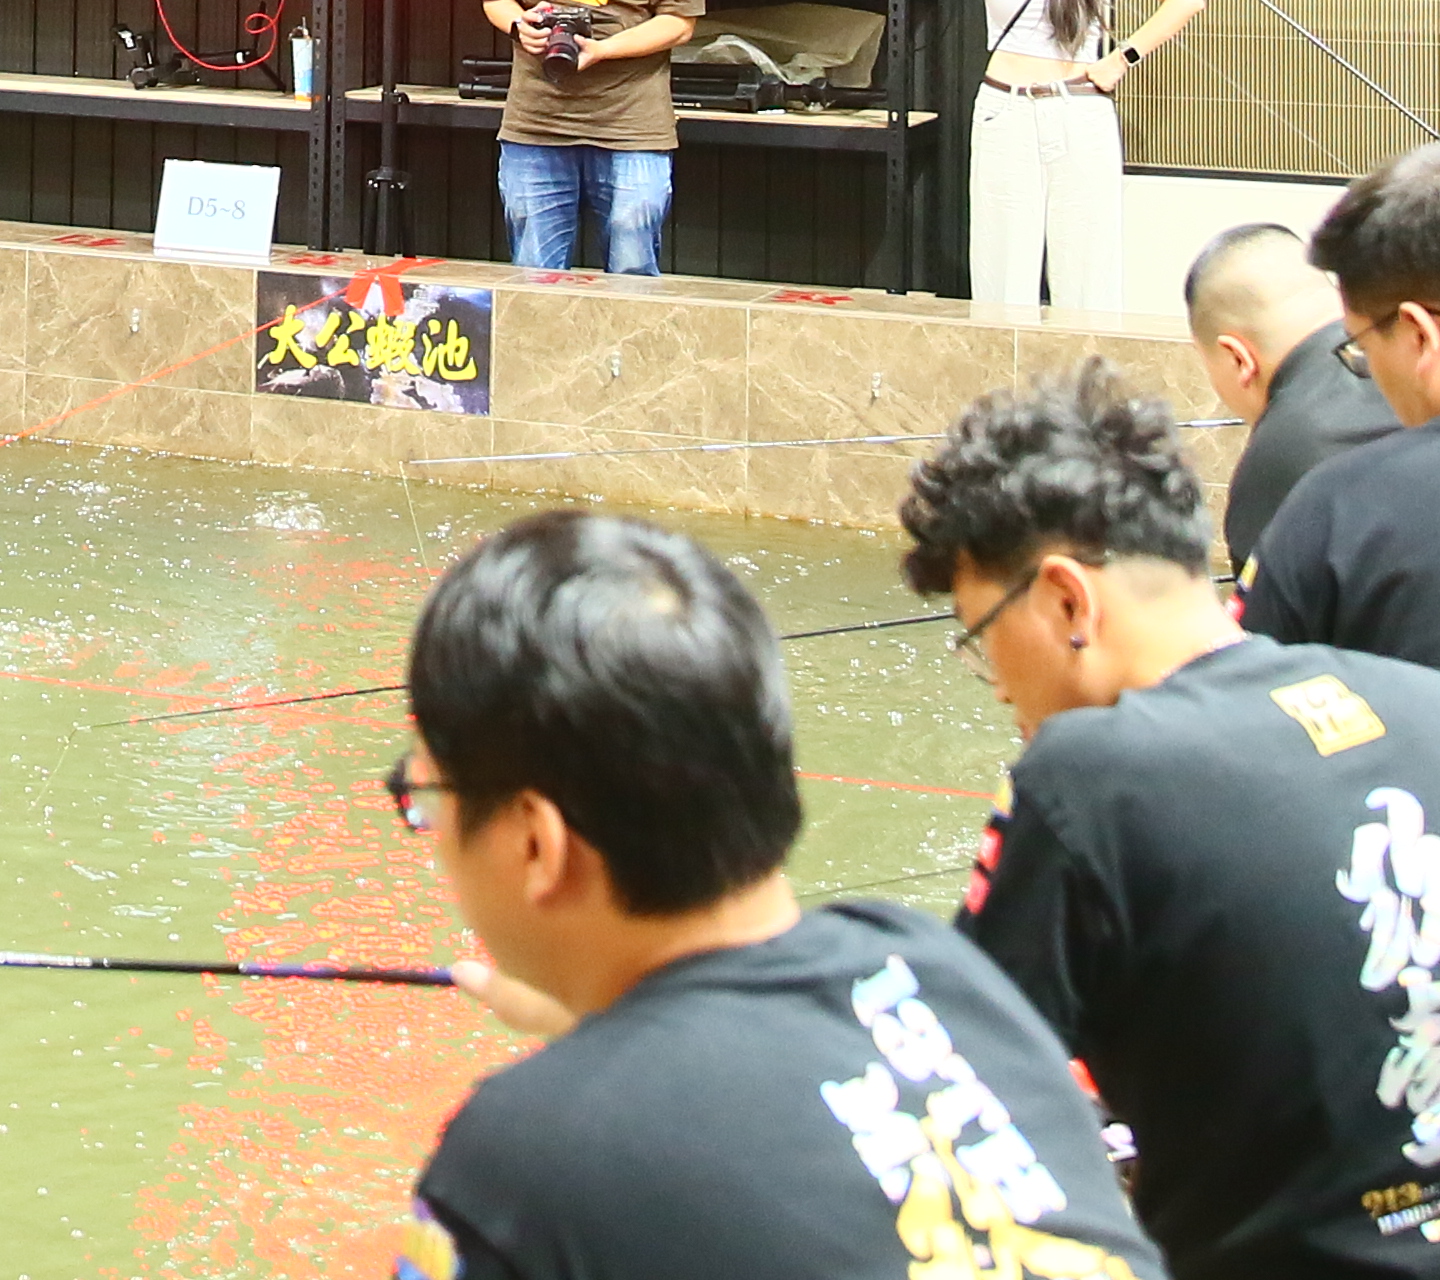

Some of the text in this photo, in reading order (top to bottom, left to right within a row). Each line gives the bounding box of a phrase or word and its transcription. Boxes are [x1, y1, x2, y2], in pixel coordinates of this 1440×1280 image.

[187, 195, 246, 220] D5~8
[269, 304, 478, 382] 大公蝦池
